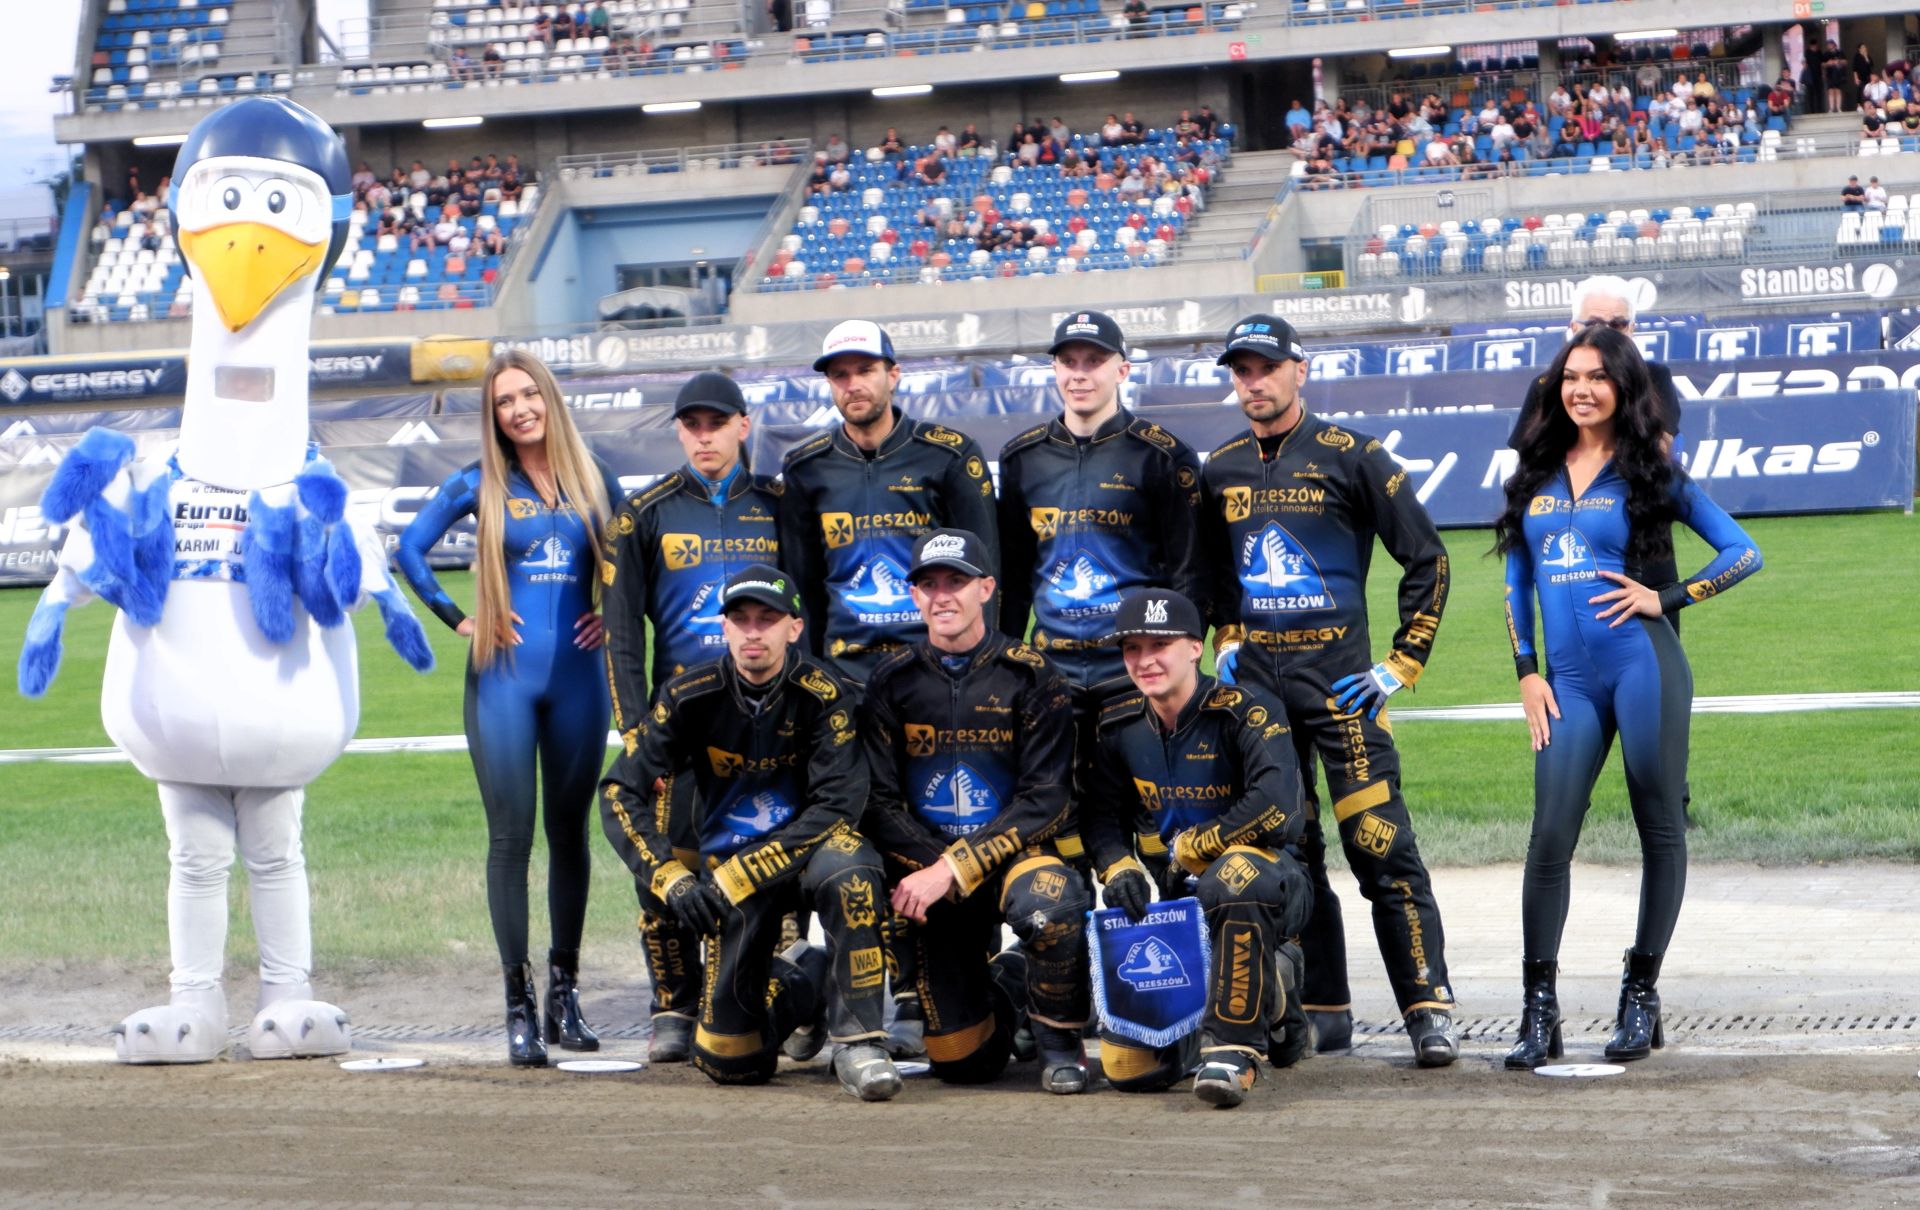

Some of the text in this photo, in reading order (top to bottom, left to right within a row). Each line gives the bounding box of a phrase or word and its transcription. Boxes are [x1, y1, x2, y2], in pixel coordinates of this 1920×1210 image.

[1740, 262, 1852, 295] Stanbest
[1504, 278, 1575, 308] Stanb
[1273, 293, 1392, 314] ENERGETYK
[887, 319, 948, 337] GETYK
[628, 331, 737, 351] ENERGETYK
[31, 368, 162, 393] GCENERGY
[1482, 437, 1862, 487] Mlkas
[1252, 486, 1325, 502] rzeszów
[1556, 497, 1616, 509] rzeszów
[174, 502, 250, 522] Eurob
[1061, 508, 1134, 525] rzeszów
[1252, 503, 1325, 515] stolica innowacji
[174, 520, 205, 530] Grupa
[854, 511, 932, 529] rzeszów
[175, 539, 220, 553] KARMI
[525, 539, 542, 557] STAL
[704, 536, 779, 553] rzeszów
[1243, 535, 1258, 567] STAL
[1543, 533, 1555, 554] STAL
[1287, 553, 1304, 564] ZK
[1713, 547, 1756, 588] rzeszów
[849, 564, 868, 589] STAL
[1051, 561, 1068, 585] STAL
[1292, 563, 1300, 574] S
[1551, 571, 1596, 583] RZESZÓW
[692, 584, 714, 611] STAL
[1252, 594, 1325, 610] RZESZÓW
[859, 610, 924, 623] RZESZÓW
[1061, 601, 1122, 617] RZESZÓW
[1144, 613, 1168, 623] MED
[1249, 626, 1348, 644] GCENERGY
[938, 728, 1013, 744] rzeszów
[1347, 719, 1370, 782] rzeszów
[925, 772, 945, 799] STAL
[973, 789, 989, 798] ZK
[1160, 784, 1232, 800] rzeszów
[775, 806, 788, 815] ZK
[977, 797, 984, 806] S
[940, 823, 988, 836] RZESZÓ
[1262, 811, 1287, 833] RES
[975, 826, 1023, 872] FIAT
[743, 841, 791, 883] FIAT
[1104, 917, 1132, 930] STAL
[854, 951, 879, 971] WAR
[1128, 944, 1142, 965] STAL
[1138, 977, 1184, 989] RZESZÓW
